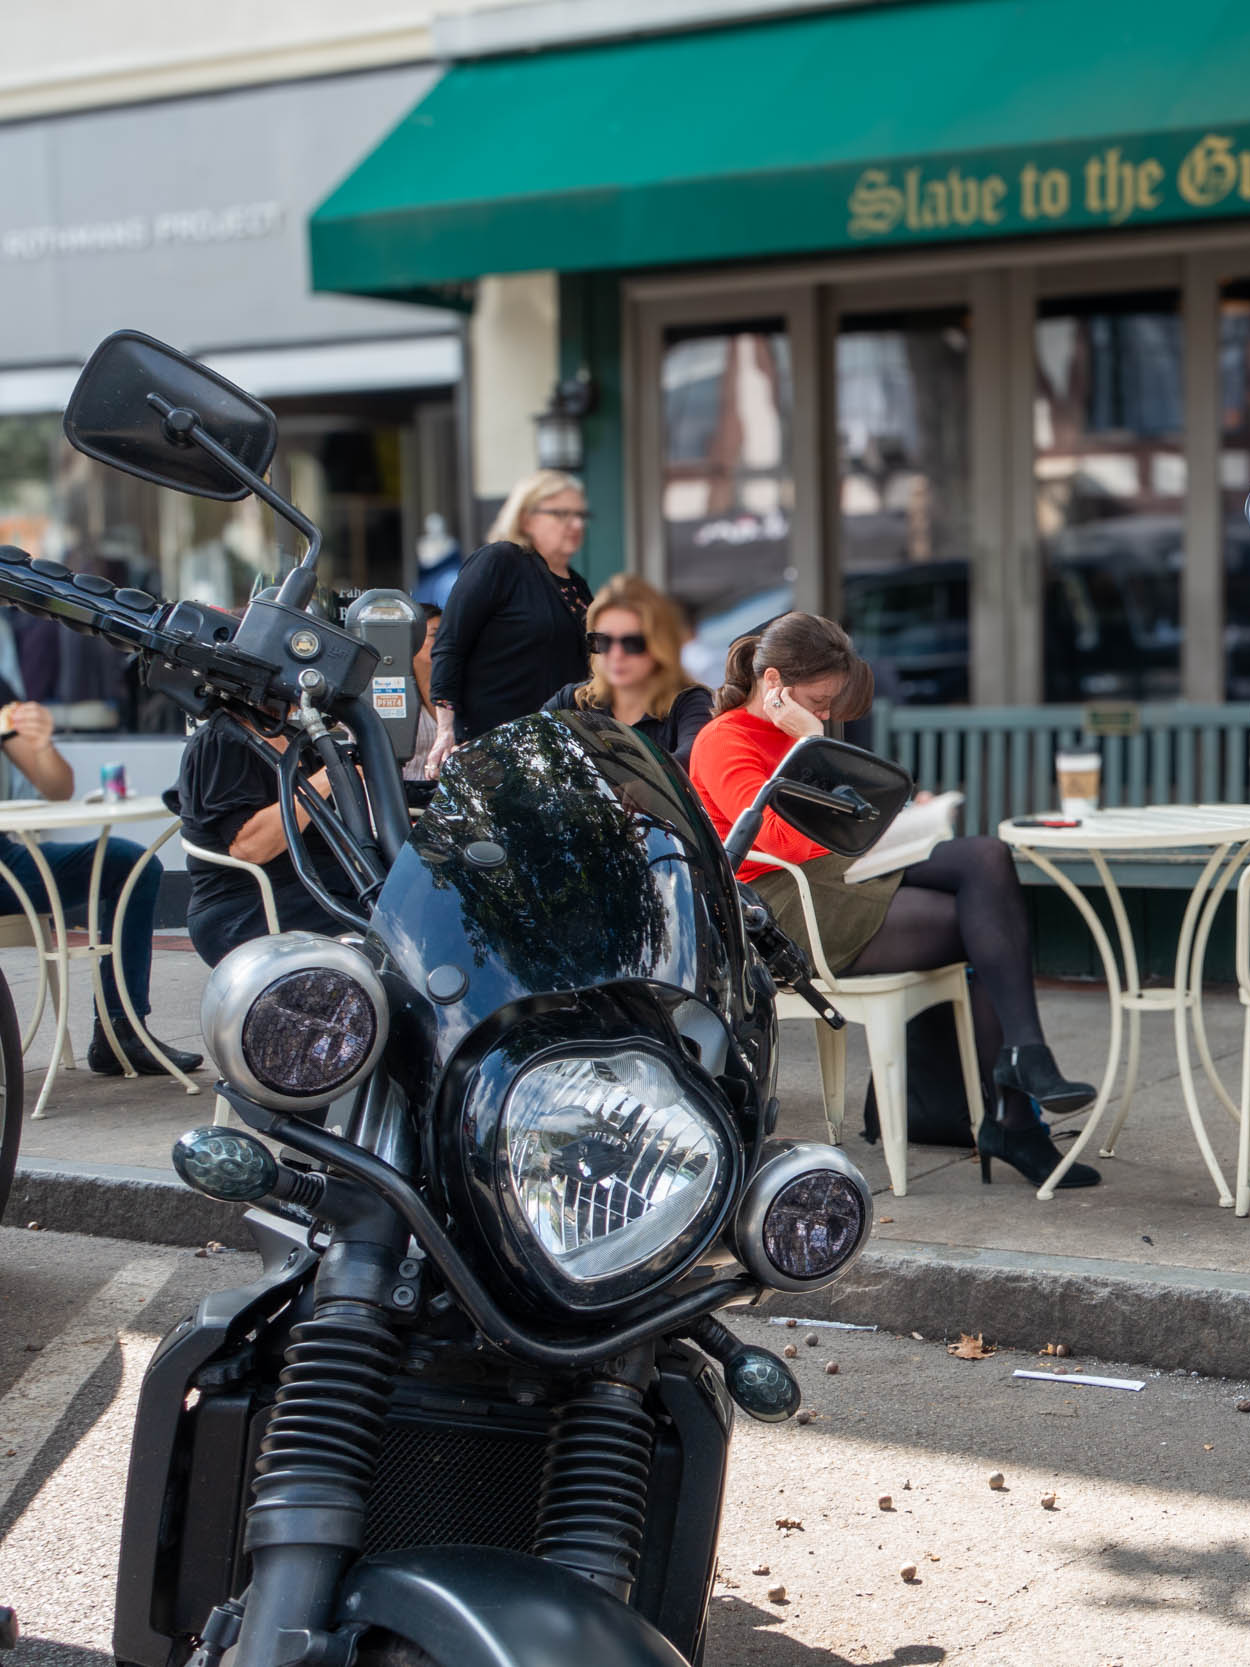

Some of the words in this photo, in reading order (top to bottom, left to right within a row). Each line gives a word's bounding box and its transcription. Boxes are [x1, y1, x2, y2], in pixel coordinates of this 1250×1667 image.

[848, 167, 1007, 238] Slave
[1020, 161, 1070, 220] to
[1084, 146, 1165, 225] the
